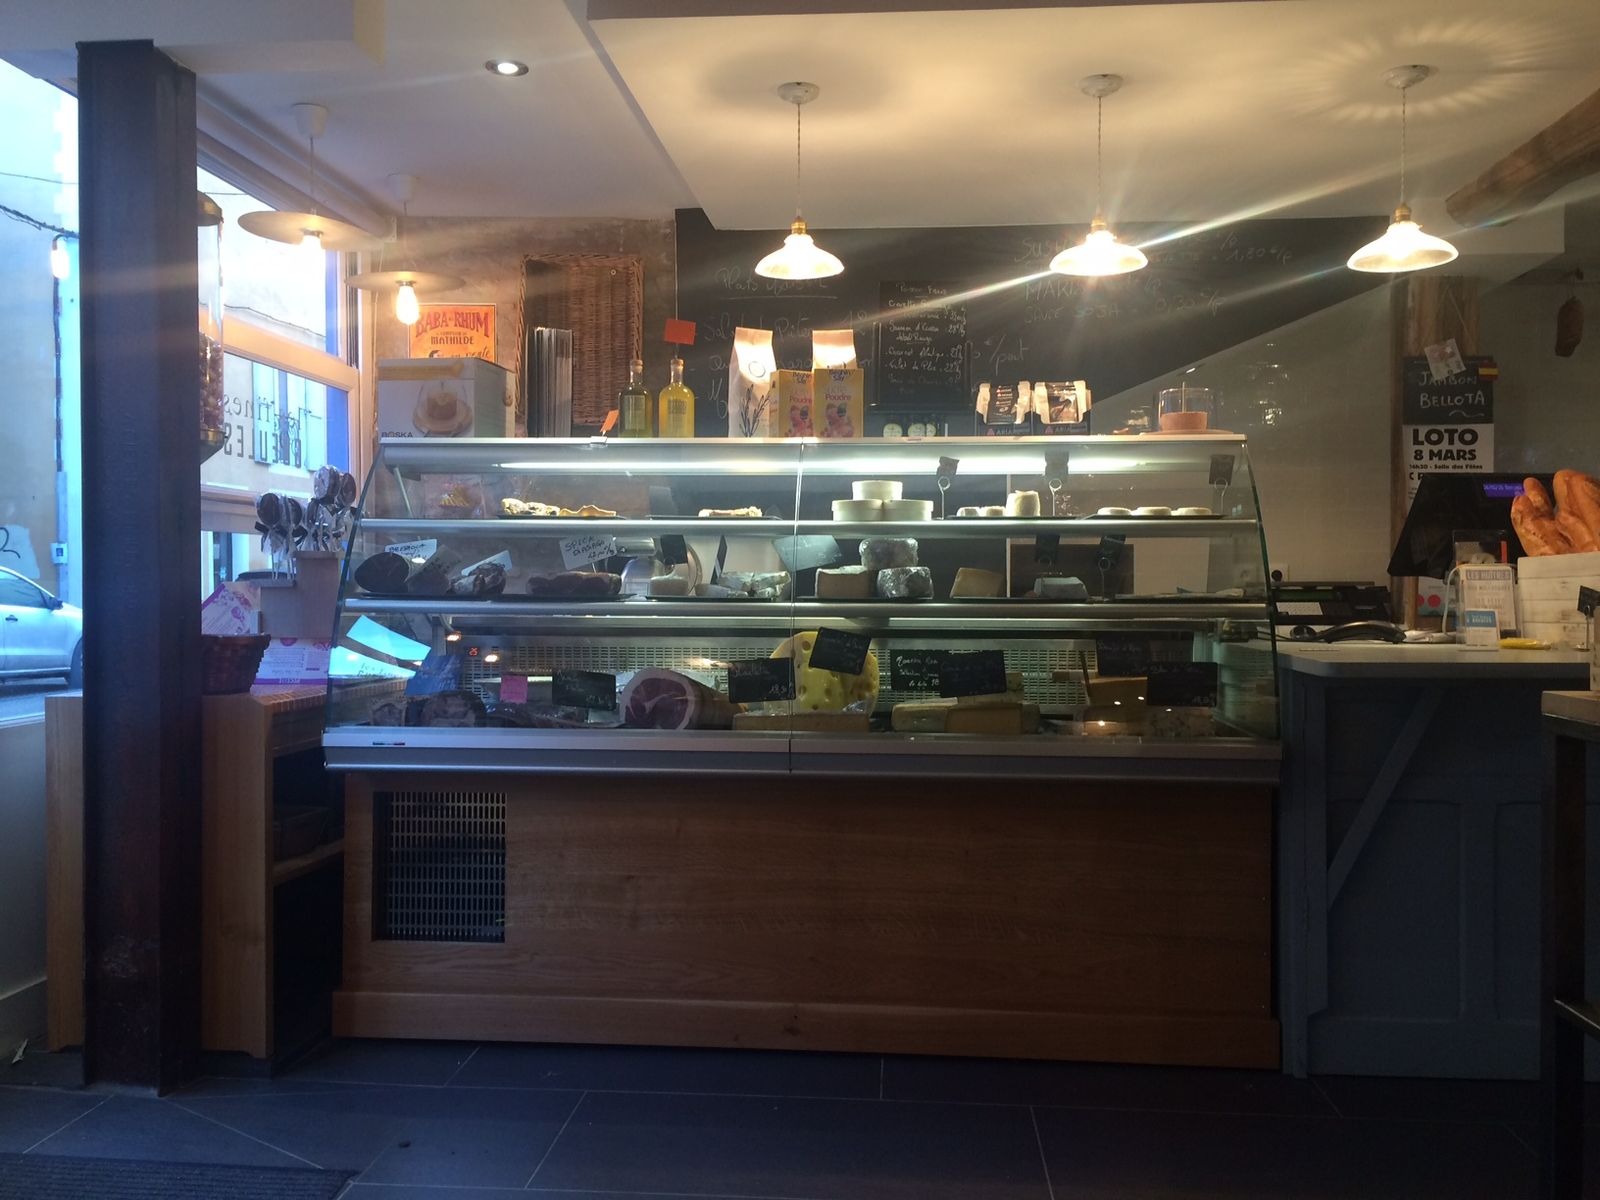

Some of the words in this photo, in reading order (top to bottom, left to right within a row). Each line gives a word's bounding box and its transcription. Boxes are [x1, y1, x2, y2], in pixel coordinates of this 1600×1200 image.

[431, 336, 475, 345] MATHILDE
[1420, 390, 1485, 409] BELLOTA
[1412, 428, 1479, 446] LOTO
[1413, 449, 1424, 461] 8
[1429, 449, 1477, 461] MARS
